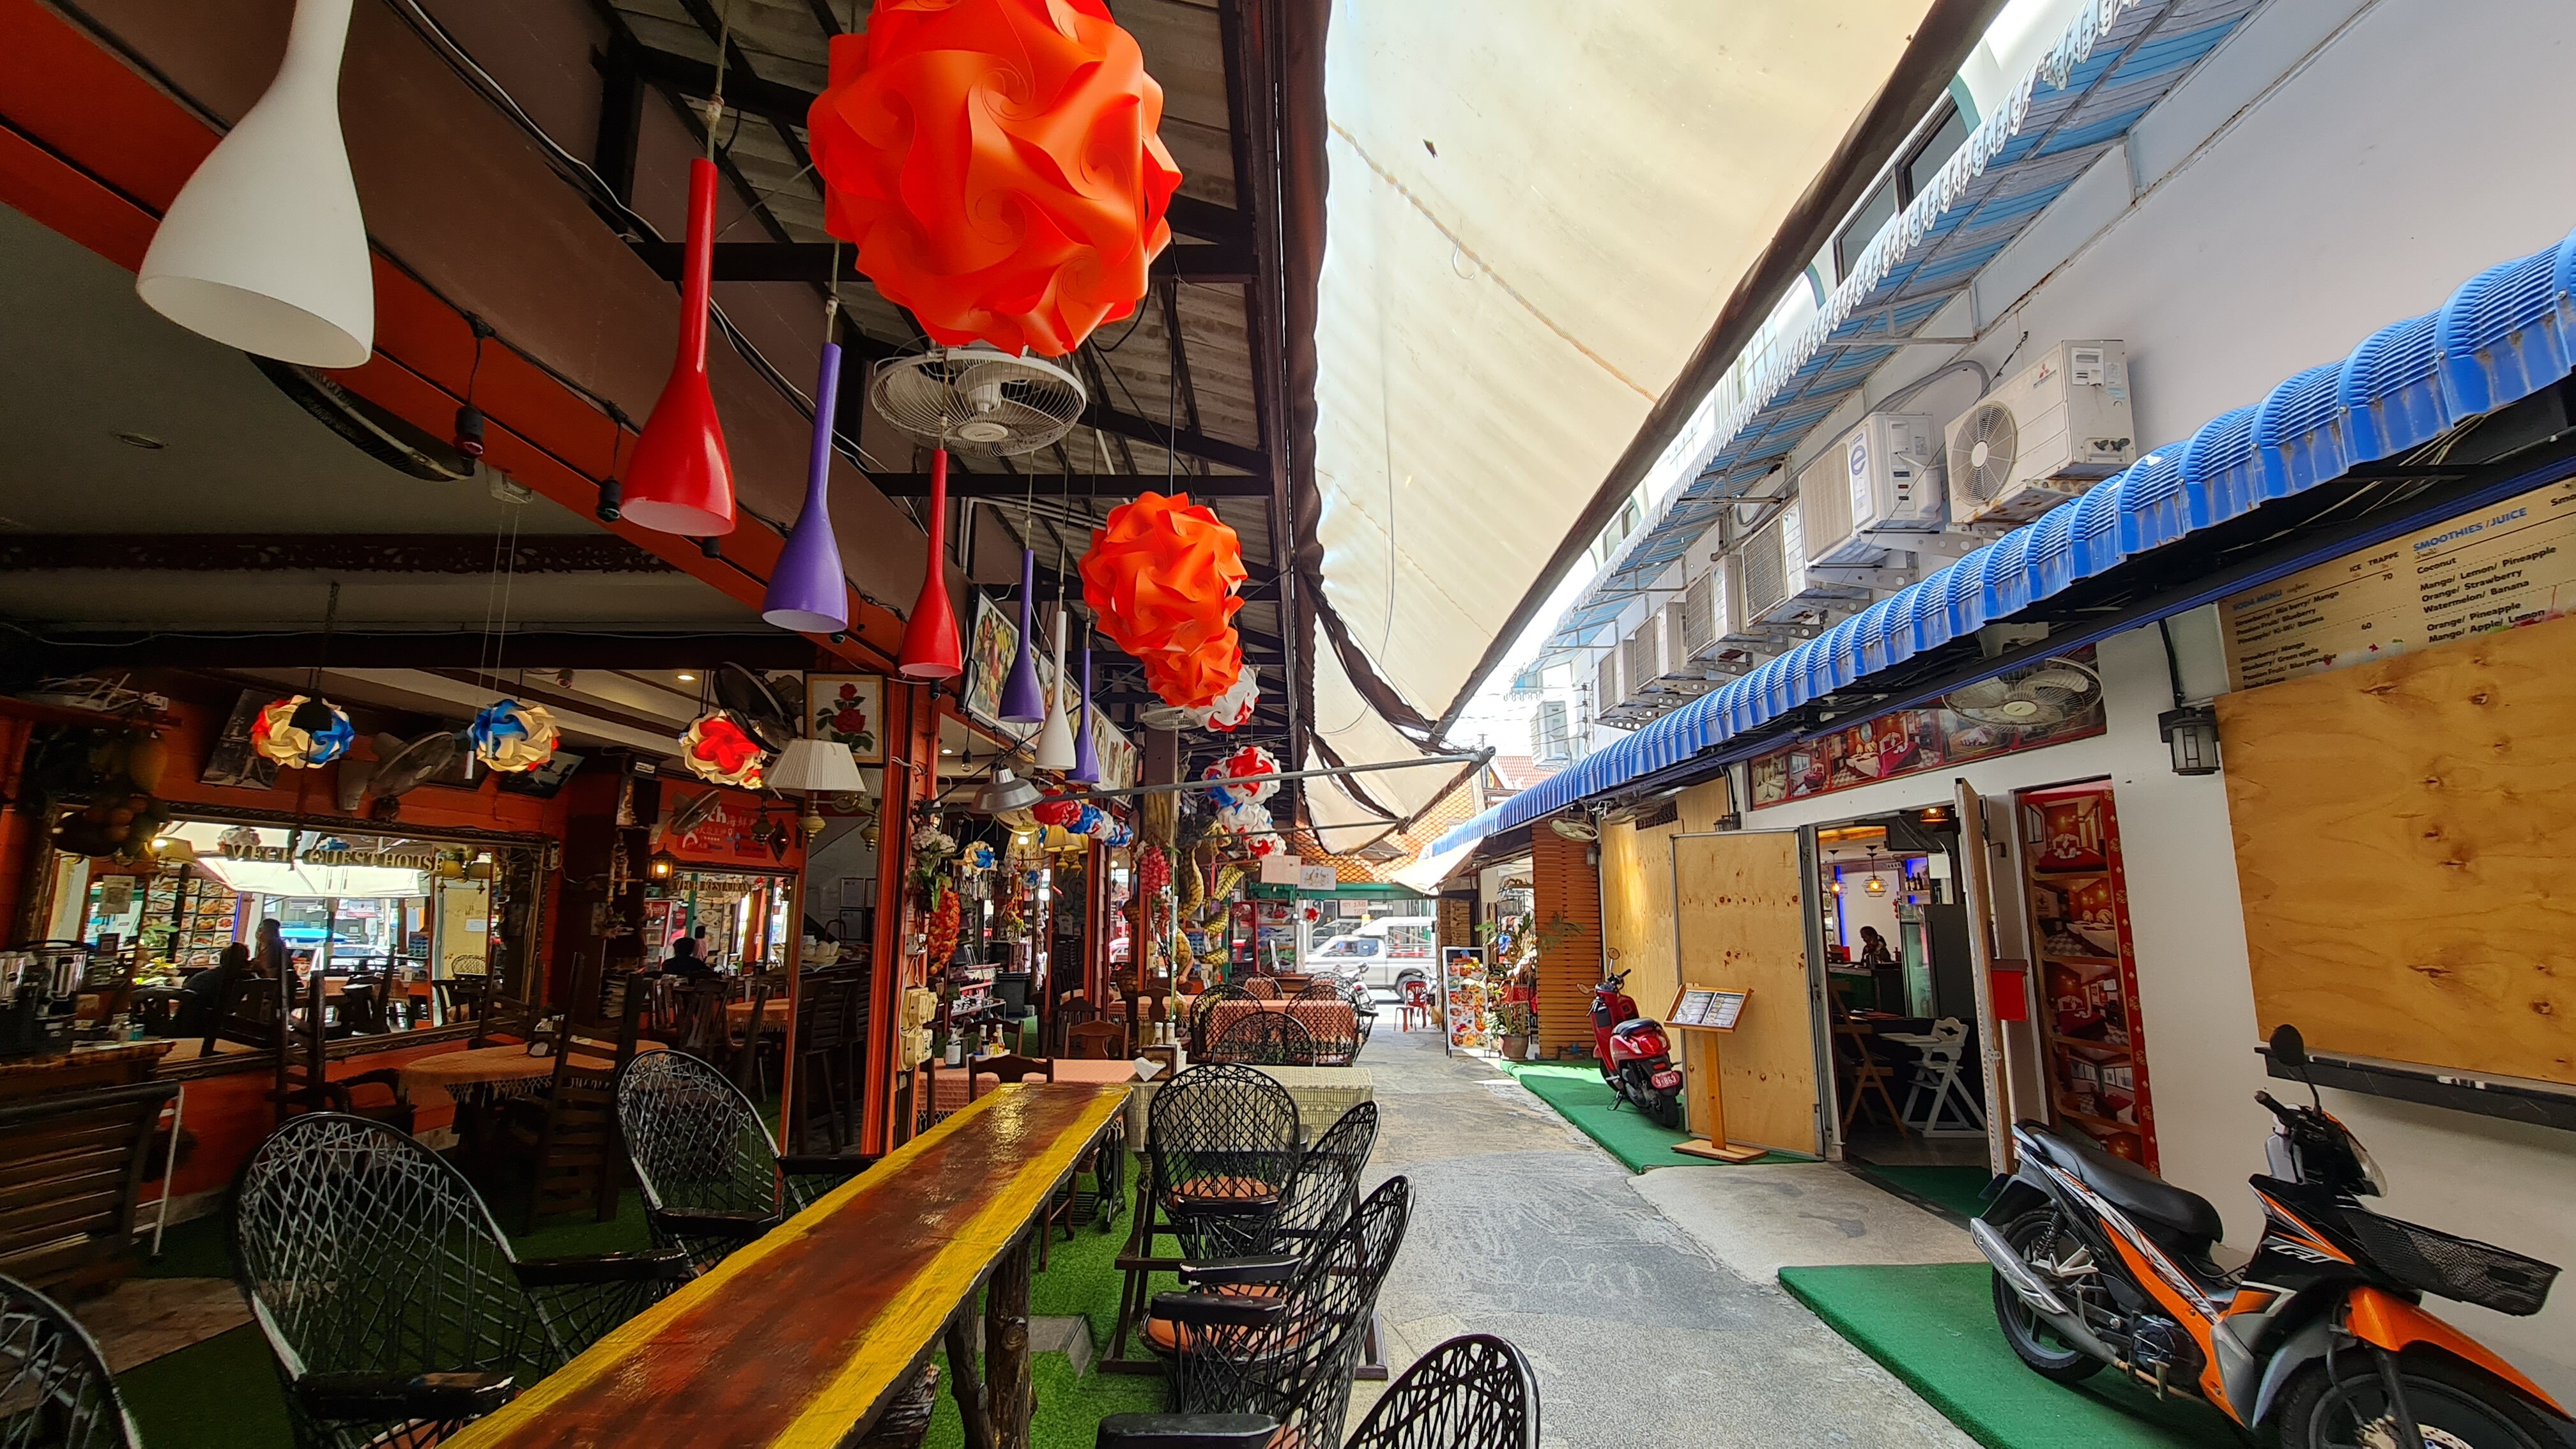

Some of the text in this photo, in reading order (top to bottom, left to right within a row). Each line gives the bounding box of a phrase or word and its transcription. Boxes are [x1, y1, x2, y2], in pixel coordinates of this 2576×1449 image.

[2413, 522, 2483, 551] SMOOTHIES
[2349, 564, 2361, 573] ICE
[2368, 551, 2399, 566] TRAPPE
[2417, 557, 2457, 574] Coconut
[2420, 546, 2557, 592] Mango/ Lemon/ Pineapple
[2382, 572, 2393, 581] 70
[2422, 570, 2522, 602] Orange/ Strawberry
[2313, 590, 2340, 603] Mango
[2423, 580, 2529, 613] Watermelon/ Banana
[2281, 608, 2317, 623] Blueberry
[2297, 616, 2324, 628] Banana
[2427, 602, 2522, 632] Orange/ Pineapple
[2361, 622, 2372, 631] 60
[2429, 609, 2545, 643] Mango/ Apple/ Lemon
[2278, 652, 2298, 663] Green
[2299, 647, 2319, 659] apple
[2281, 641, 2306, 653] Mango
[2289, 659, 2305, 670] Blue
[309, 849, 378, 866] GUEST
[383, 853, 444, 872] HOUSE
